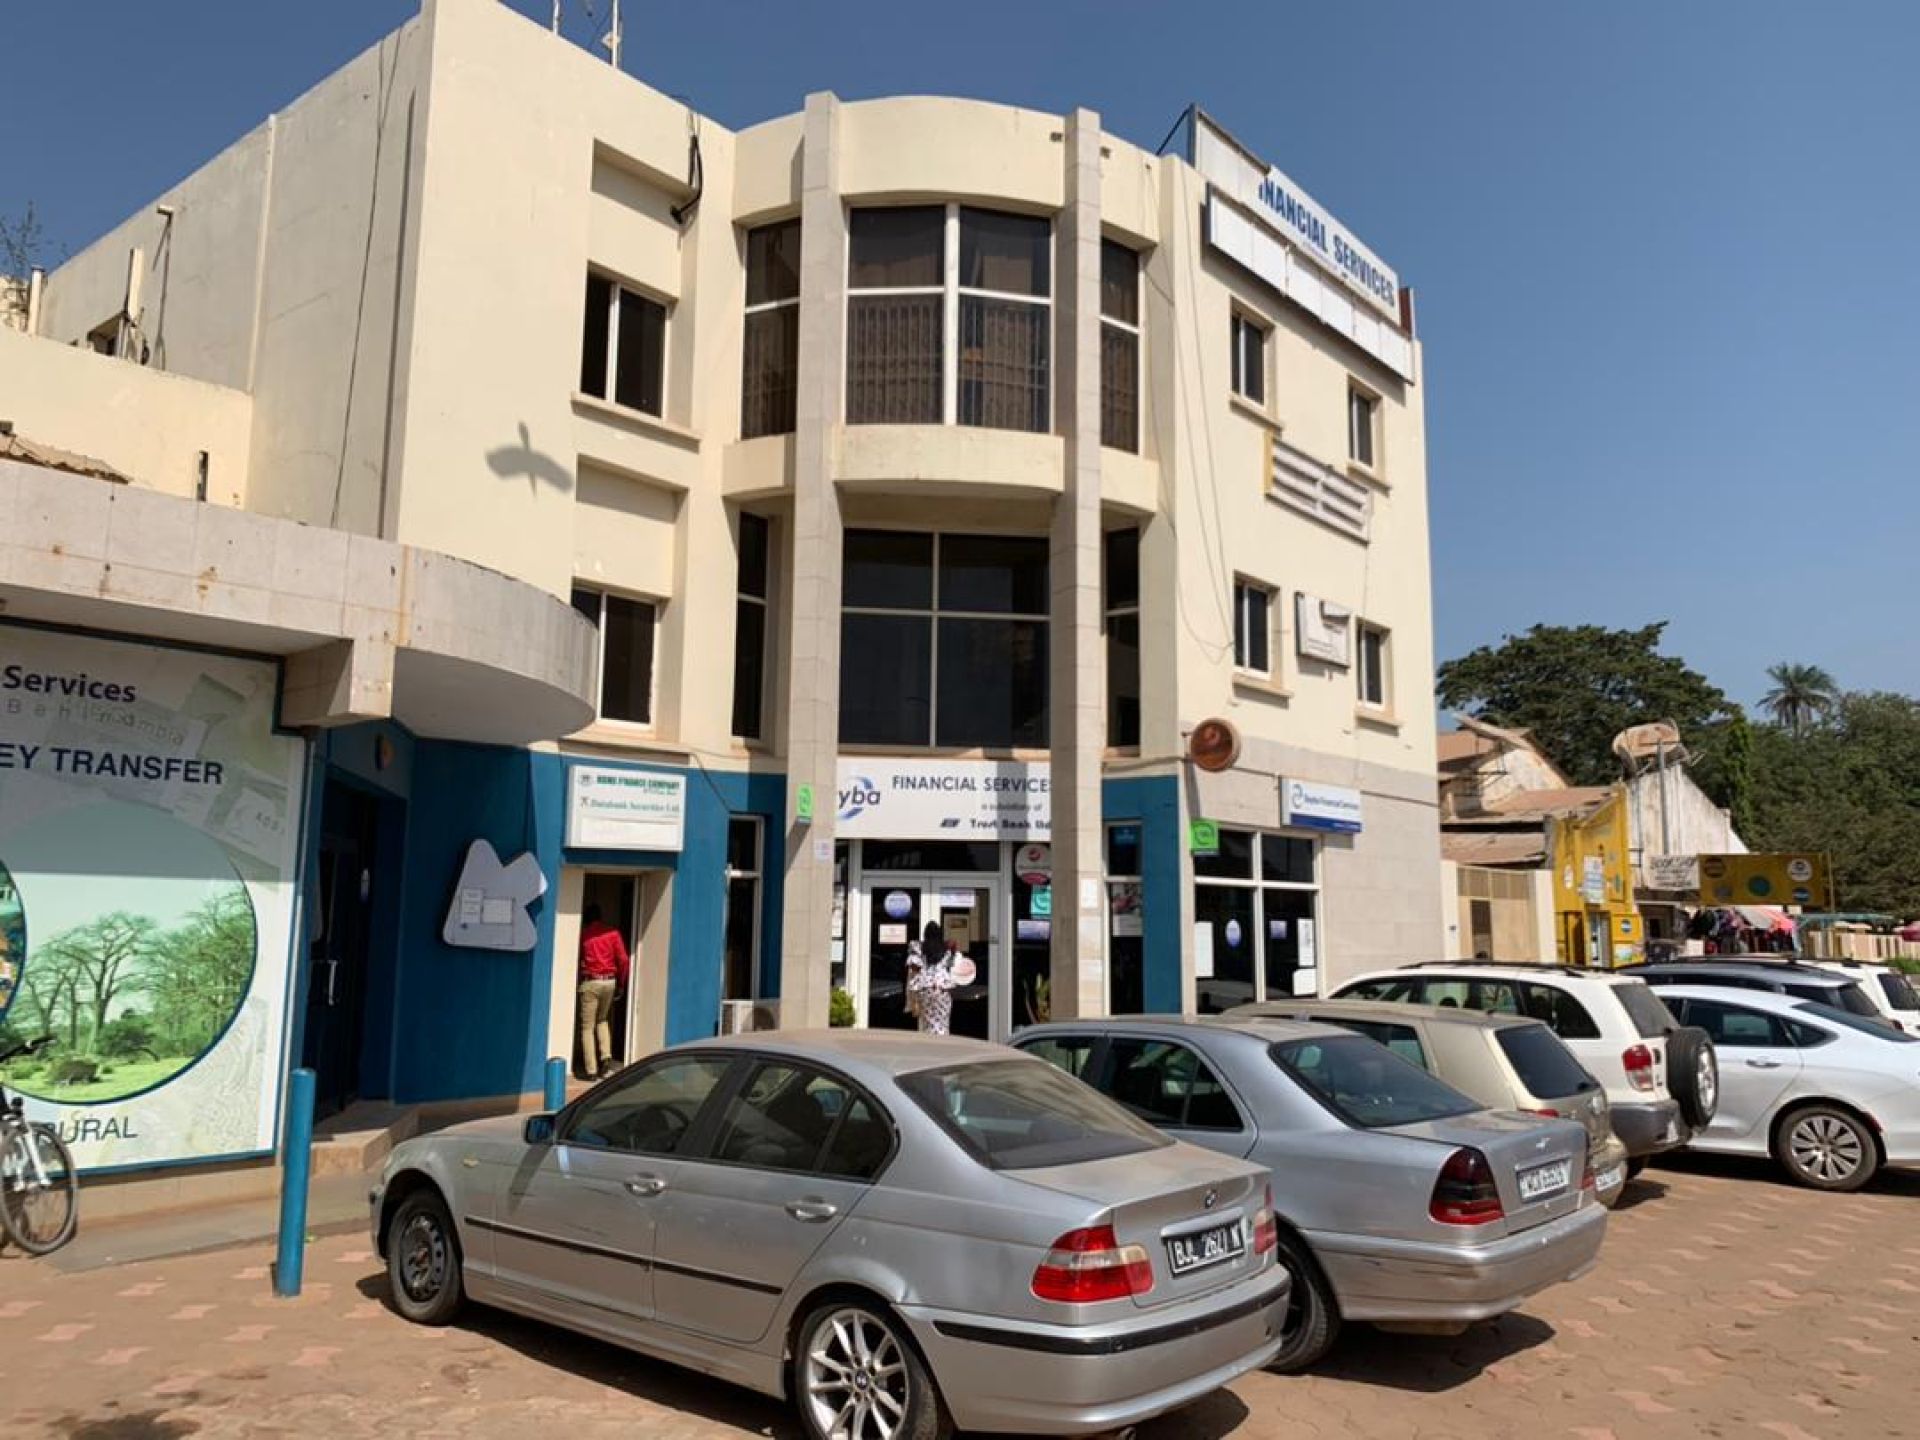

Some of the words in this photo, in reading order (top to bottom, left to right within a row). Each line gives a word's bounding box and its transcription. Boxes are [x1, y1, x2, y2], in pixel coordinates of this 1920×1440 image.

[1333, 234, 1395, 307] SERVICES
[3, 664, 136, 703] Services
[50, 747, 224, 785] TRANSFER
[891, 775, 977, 792] FINANCIAL
[984, 776, 1053, 793] SERVICE
